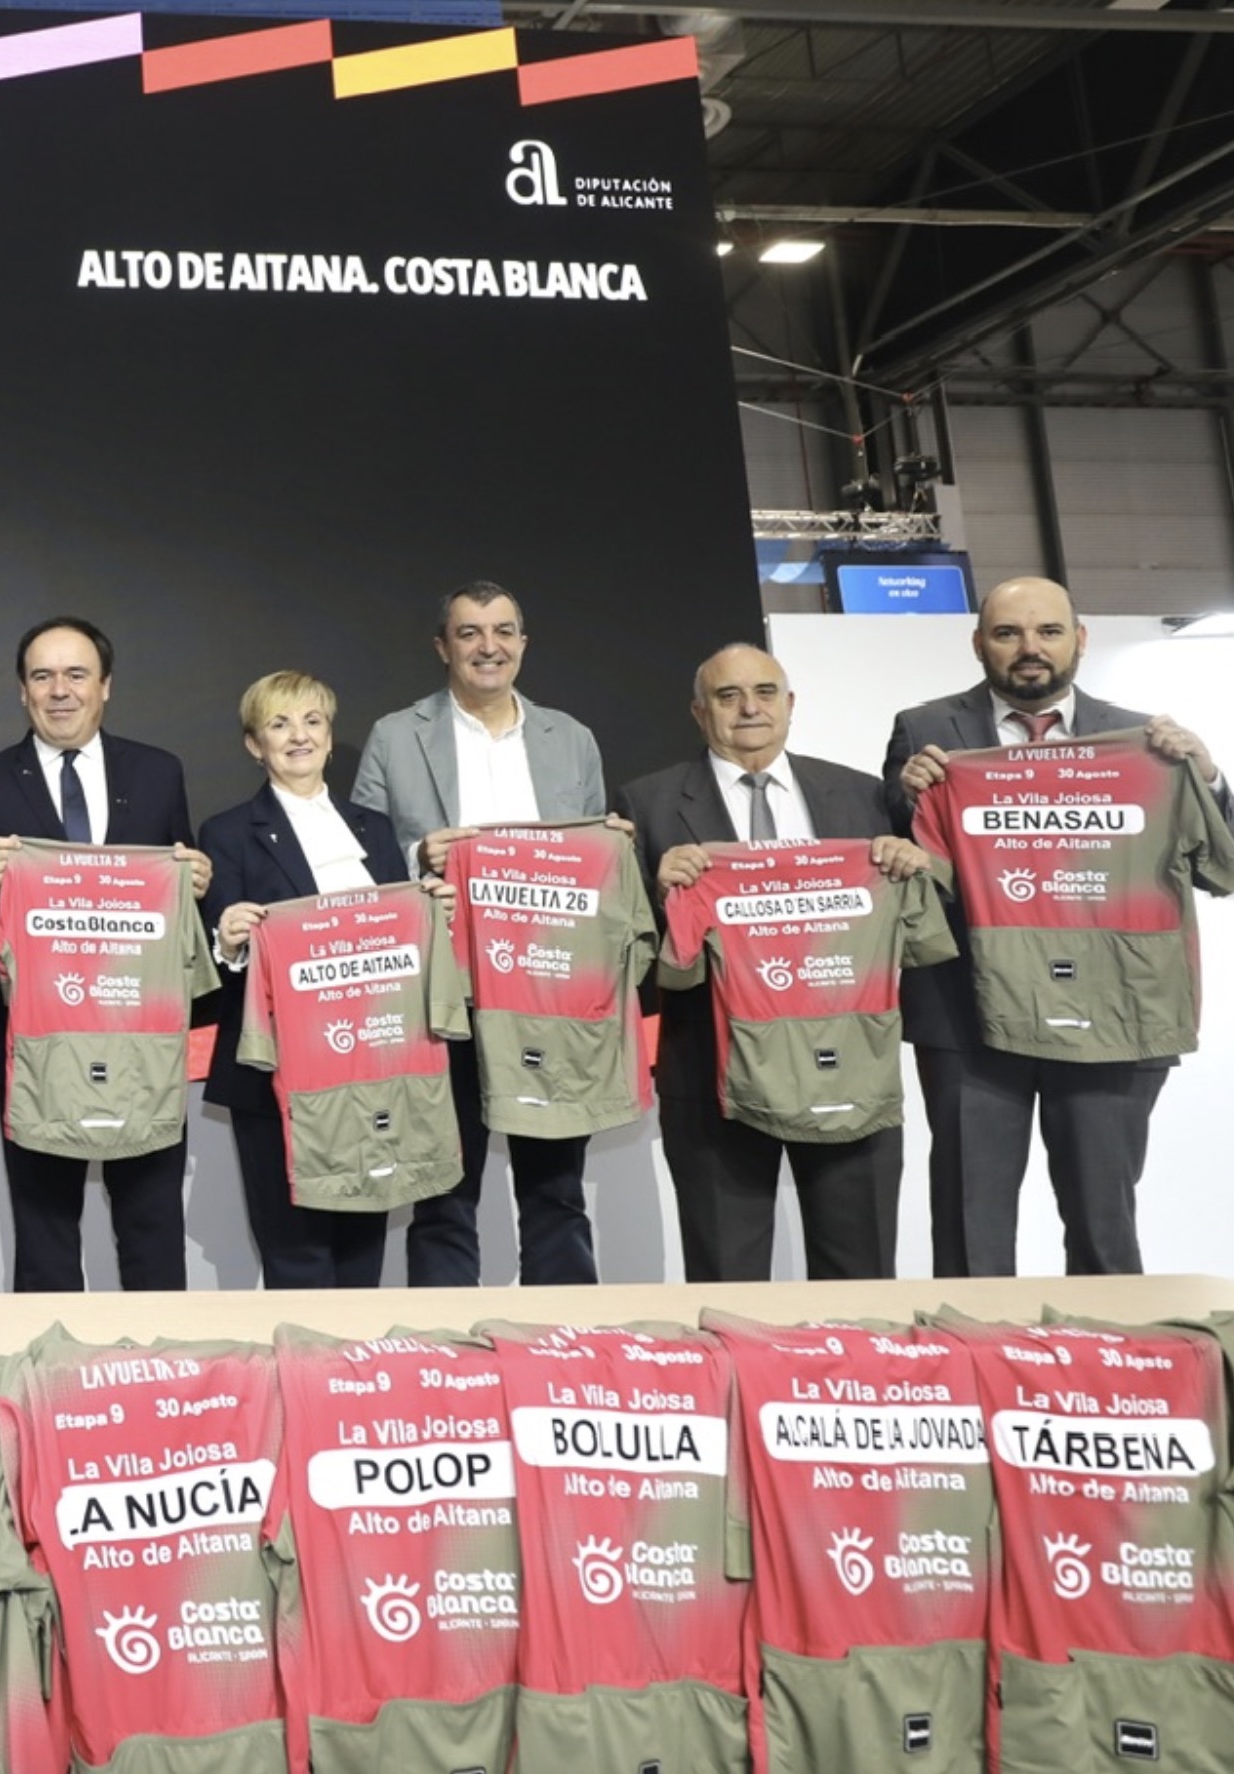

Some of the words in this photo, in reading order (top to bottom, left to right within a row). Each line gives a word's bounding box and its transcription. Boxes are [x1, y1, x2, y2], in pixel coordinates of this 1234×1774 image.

[575, 176, 671, 193] DIPUTACIÓN
[577, 194, 595, 208] DE
[600, 196, 673, 210] ALICANTE
[78, 250, 172, 288] ALTO
[178, 253, 224, 289] DE
[229, 254, 378, 293] AITANA.
[384, 257, 500, 296] COSTA
[504, 261, 647, 301] BLANCA
[1008, 750, 1024, 761] LA
[1026, 748, 1074, 761] VUELTA
[1078, 746, 1095, 760] 26
[986, 772, 1022, 781] Etapa
[1025, 769, 1034, 779] 9
[1058, 768, 1074, 779] 30
[1076, 770, 1119, 780] Agosto
[993, 793, 1013, 804] La
[1018, 793, 1049, 804] Vila
[1054, 792, 1112, 804] Joiosa
[983, 810, 1124, 830] BENASAU
[994, 839, 1027, 849] Alto
[1032, 838, 1052, 849] de
[1056, 838, 1111, 849] Aitana
[740, 883, 758, 894] La
[762, 881, 790, 892] Vila
[795, 878, 842, 890] Joiosa
[1053, 870, 1106, 881] Costa
[472, 883, 492, 901] LA
[494, 885, 561, 909] VUELTA
[566, 891, 588, 911] 26
[1042, 882, 1106, 894] Blanca
[725, 901, 783, 918] CALLOSA
[32, 916, 155, 933] CostaBlanca
[749, 926, 777, 936] Alto
[782, 924, 800, 935] de
[804, 921, 850, 934] Aitana
[299, 965, 336, 984] ALTO
[340, 962, 360, 978] DE
[363, 954, 414, 976] AITANA
[798, 967, 854, 979] Blanca
[804, 955, 851, 967] Costa
[156, 1398, 180, 1418] 30
[182, 1394, 238, 1416] Agosto
[1016, 1385, 1050, 1409] La
[1055, 1390, 1100, 1414] Vila
[1105, 1393, 1169, 1416] Joiosa
[56, 1413, 108, 1430] Etapa
[109, 1403, 124, 1425] 9
[339, 1421, 367, 1444] La
[373, 1418, 417, 1444] Vila
[421, 1416, 500, 1439] Joiosa
[552, 1418, 701, 1462] BOLULLA
[776, 1408, 849, 1448] ALCALÁ
[854, 1418, 884, 1450] DE
[909, 1417, 988, 1450] JOVADA
[1012, 1420, 1195, 1471] TÁRBENA
[68, 1458, 100, 1481] La
[106, 1453, 154, 1478] Vila
[159, 1441, 237, 1471] Joiosa
[354, 1453, 492, 1495] POLOP
[125, 1468, 262, 1530] NUCÍA
[83, 1545, 134, 1569] Alto
[142, 1544, 172, 1566] de
[176, 1533, 252, 1559] Aitana
[899, 1530, 969, 1554] Costa
[884, 1555, 971, 1577] Blanca
[1120, 1542, 1192, 1567] Costa
[435, 1570, 514, 1592] Costa
[1101, 1561, 1194, 1588] Blanca
[180, 1599, 260, 1623] Costa
[168, 1625, 264, 1650] Blanca
